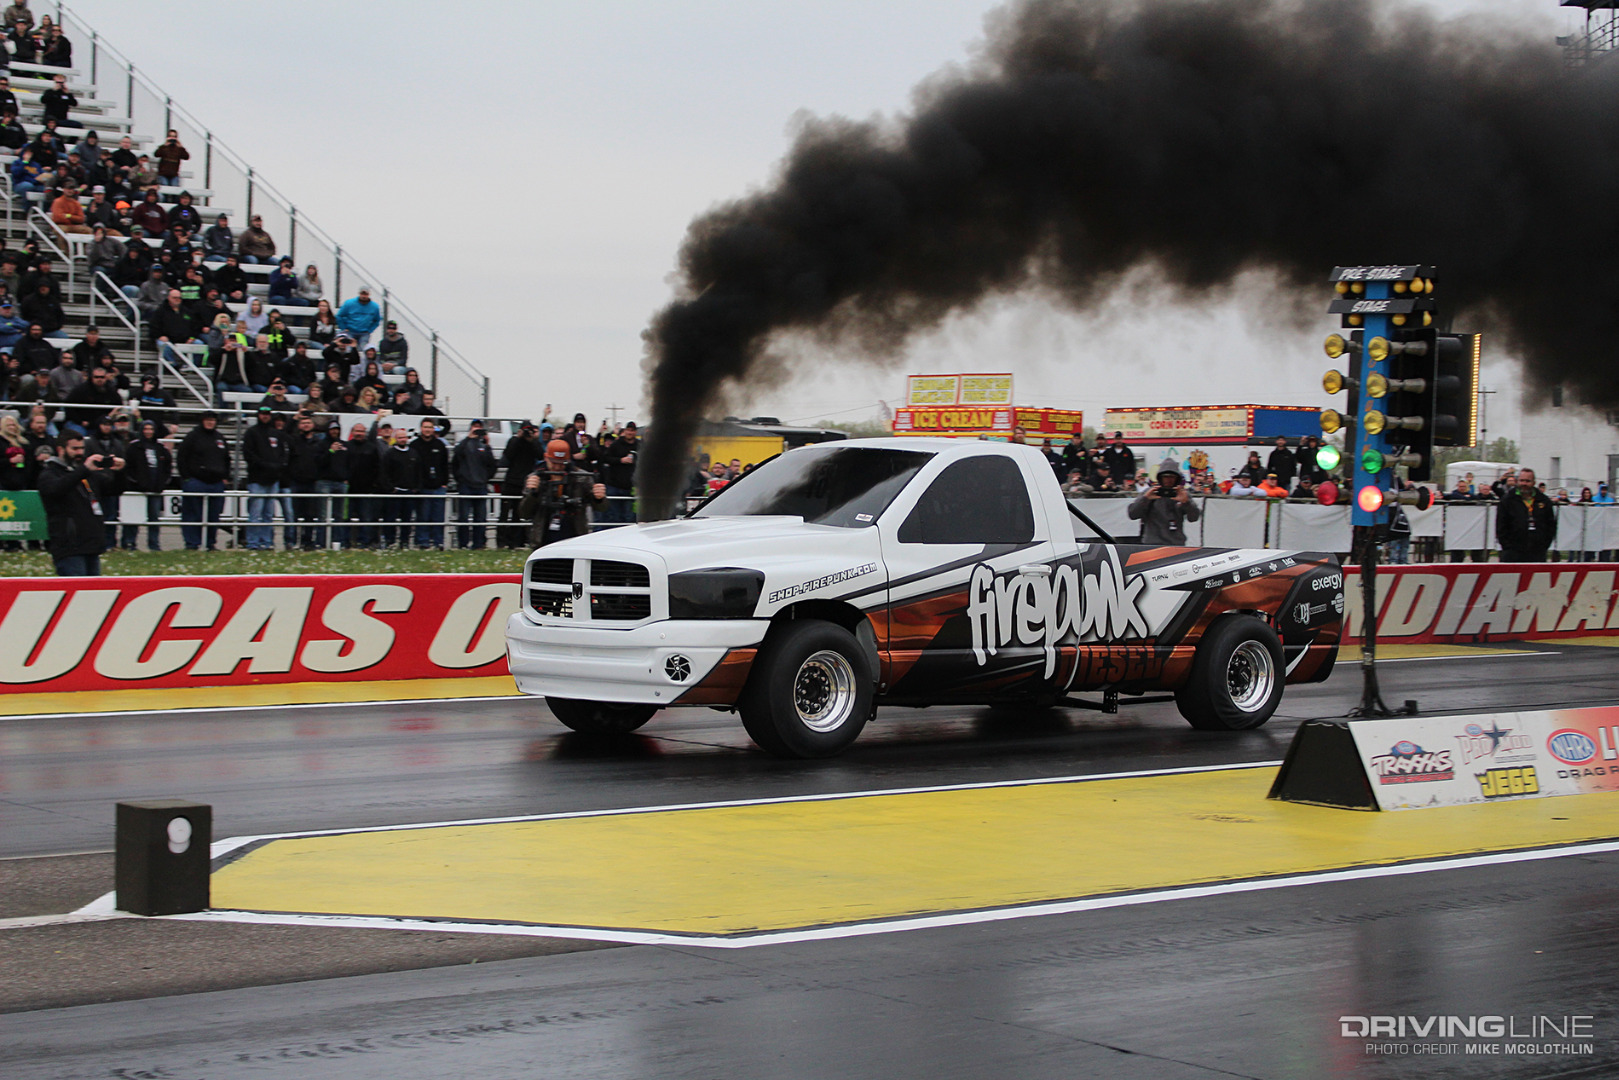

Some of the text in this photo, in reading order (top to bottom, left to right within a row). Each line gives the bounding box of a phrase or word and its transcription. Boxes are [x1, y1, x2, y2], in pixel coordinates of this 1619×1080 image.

[1350, 300, 1391, 313] STAGE
[913, 411, 938, 429] ICE
[940, 411, 993, 429] CREAM
[1149, 420, 1200, 430] CORN DOGS
[768, 562, 878, 604] SHOP.FIREPUNK.COM
[1311, 573, 1343, 591] exergy
[967, 544, 1149, 680] firepunk
[1342, 570, 1619, 638] NDIANA
[1054, 640, 1163, 687] DIESEL
[1551, 733, 1596, 761] NHRA
[1371, 749, 1455, 776] TRAXXAS
[1557, 766, 1607, 779] DRAG
[1475, 765, 1540, 798] JEGS
